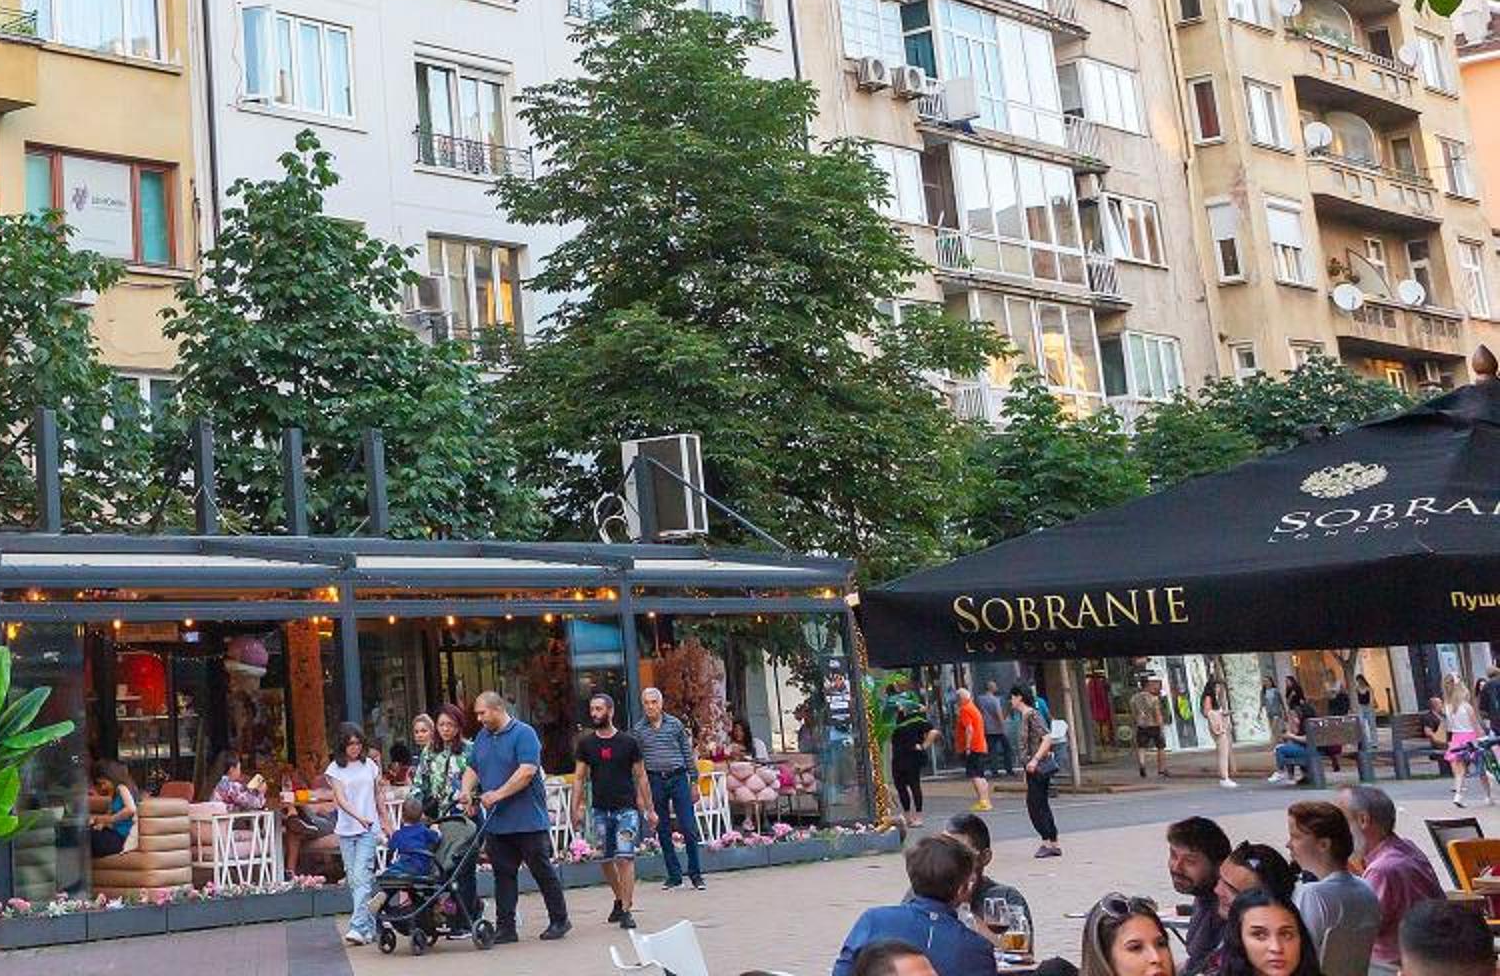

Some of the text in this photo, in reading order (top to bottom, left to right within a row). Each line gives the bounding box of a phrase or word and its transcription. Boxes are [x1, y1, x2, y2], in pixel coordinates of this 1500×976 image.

[1267, 517, 1430, 542] LONDON
[1274, 497, 1500, 533] SOBRA
[952, 586, 1189, 633] SOBRANIE
